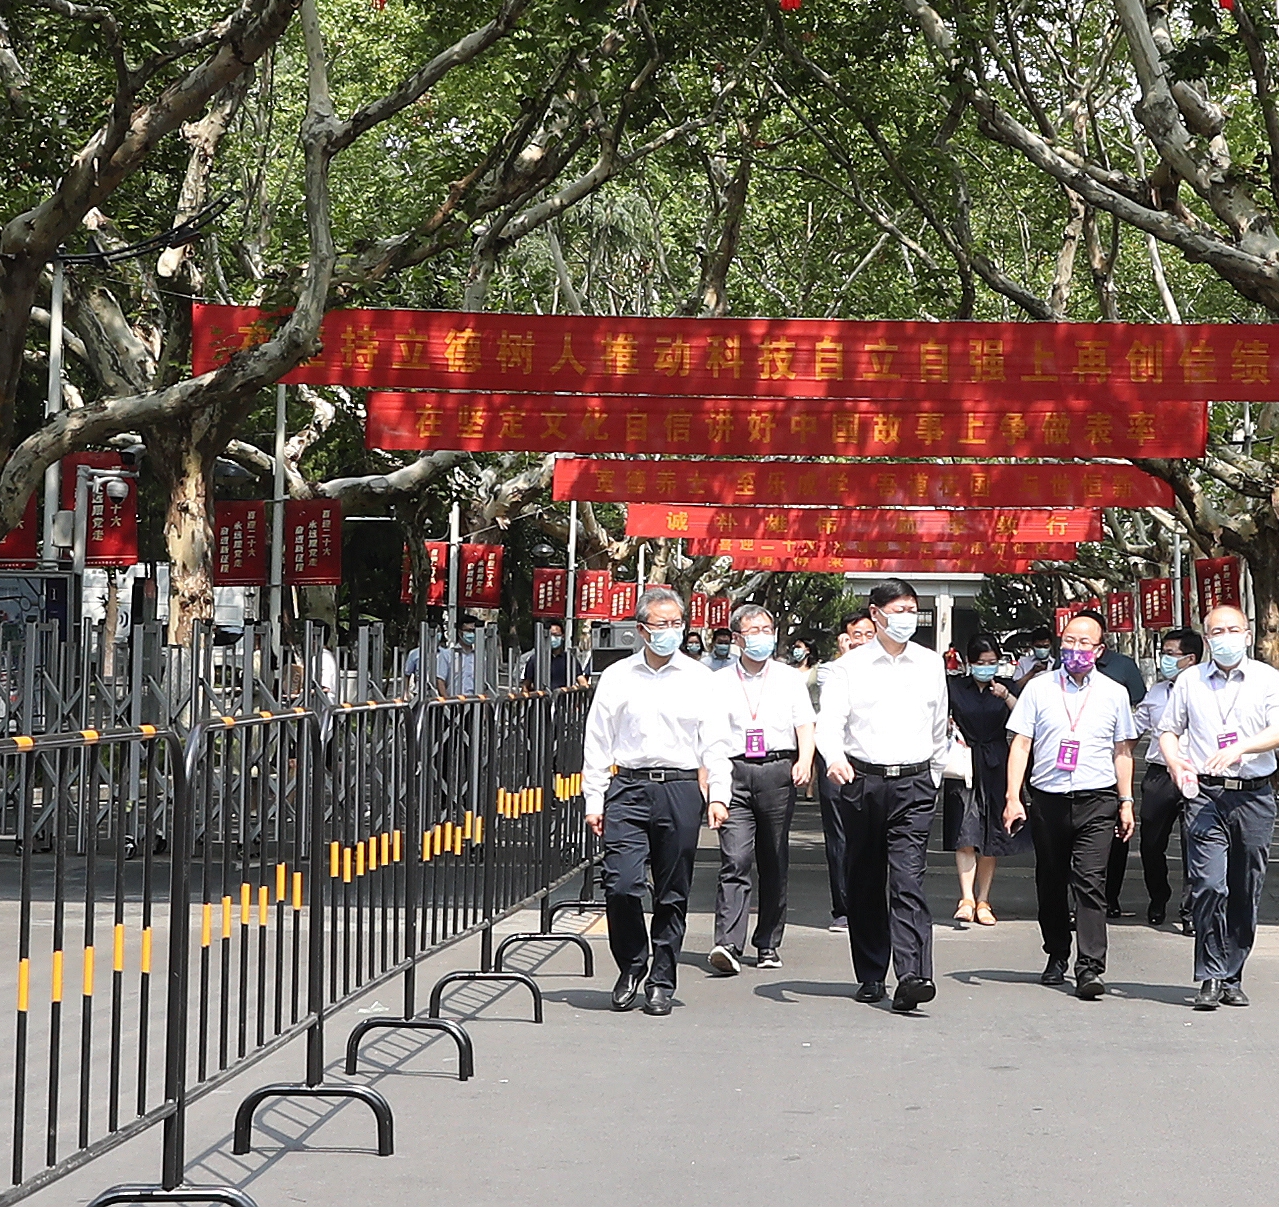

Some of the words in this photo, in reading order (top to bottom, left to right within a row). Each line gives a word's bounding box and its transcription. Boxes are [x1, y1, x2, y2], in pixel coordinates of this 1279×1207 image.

[238, 324, 1271, 385] 持立德树人推动科技自立自强上再创佳绩
[415, 404, 1156, 446] 在坚定文化自信讲好中国故事上争做表率
[666, 511, 838, 535] 诚朴雄伟
